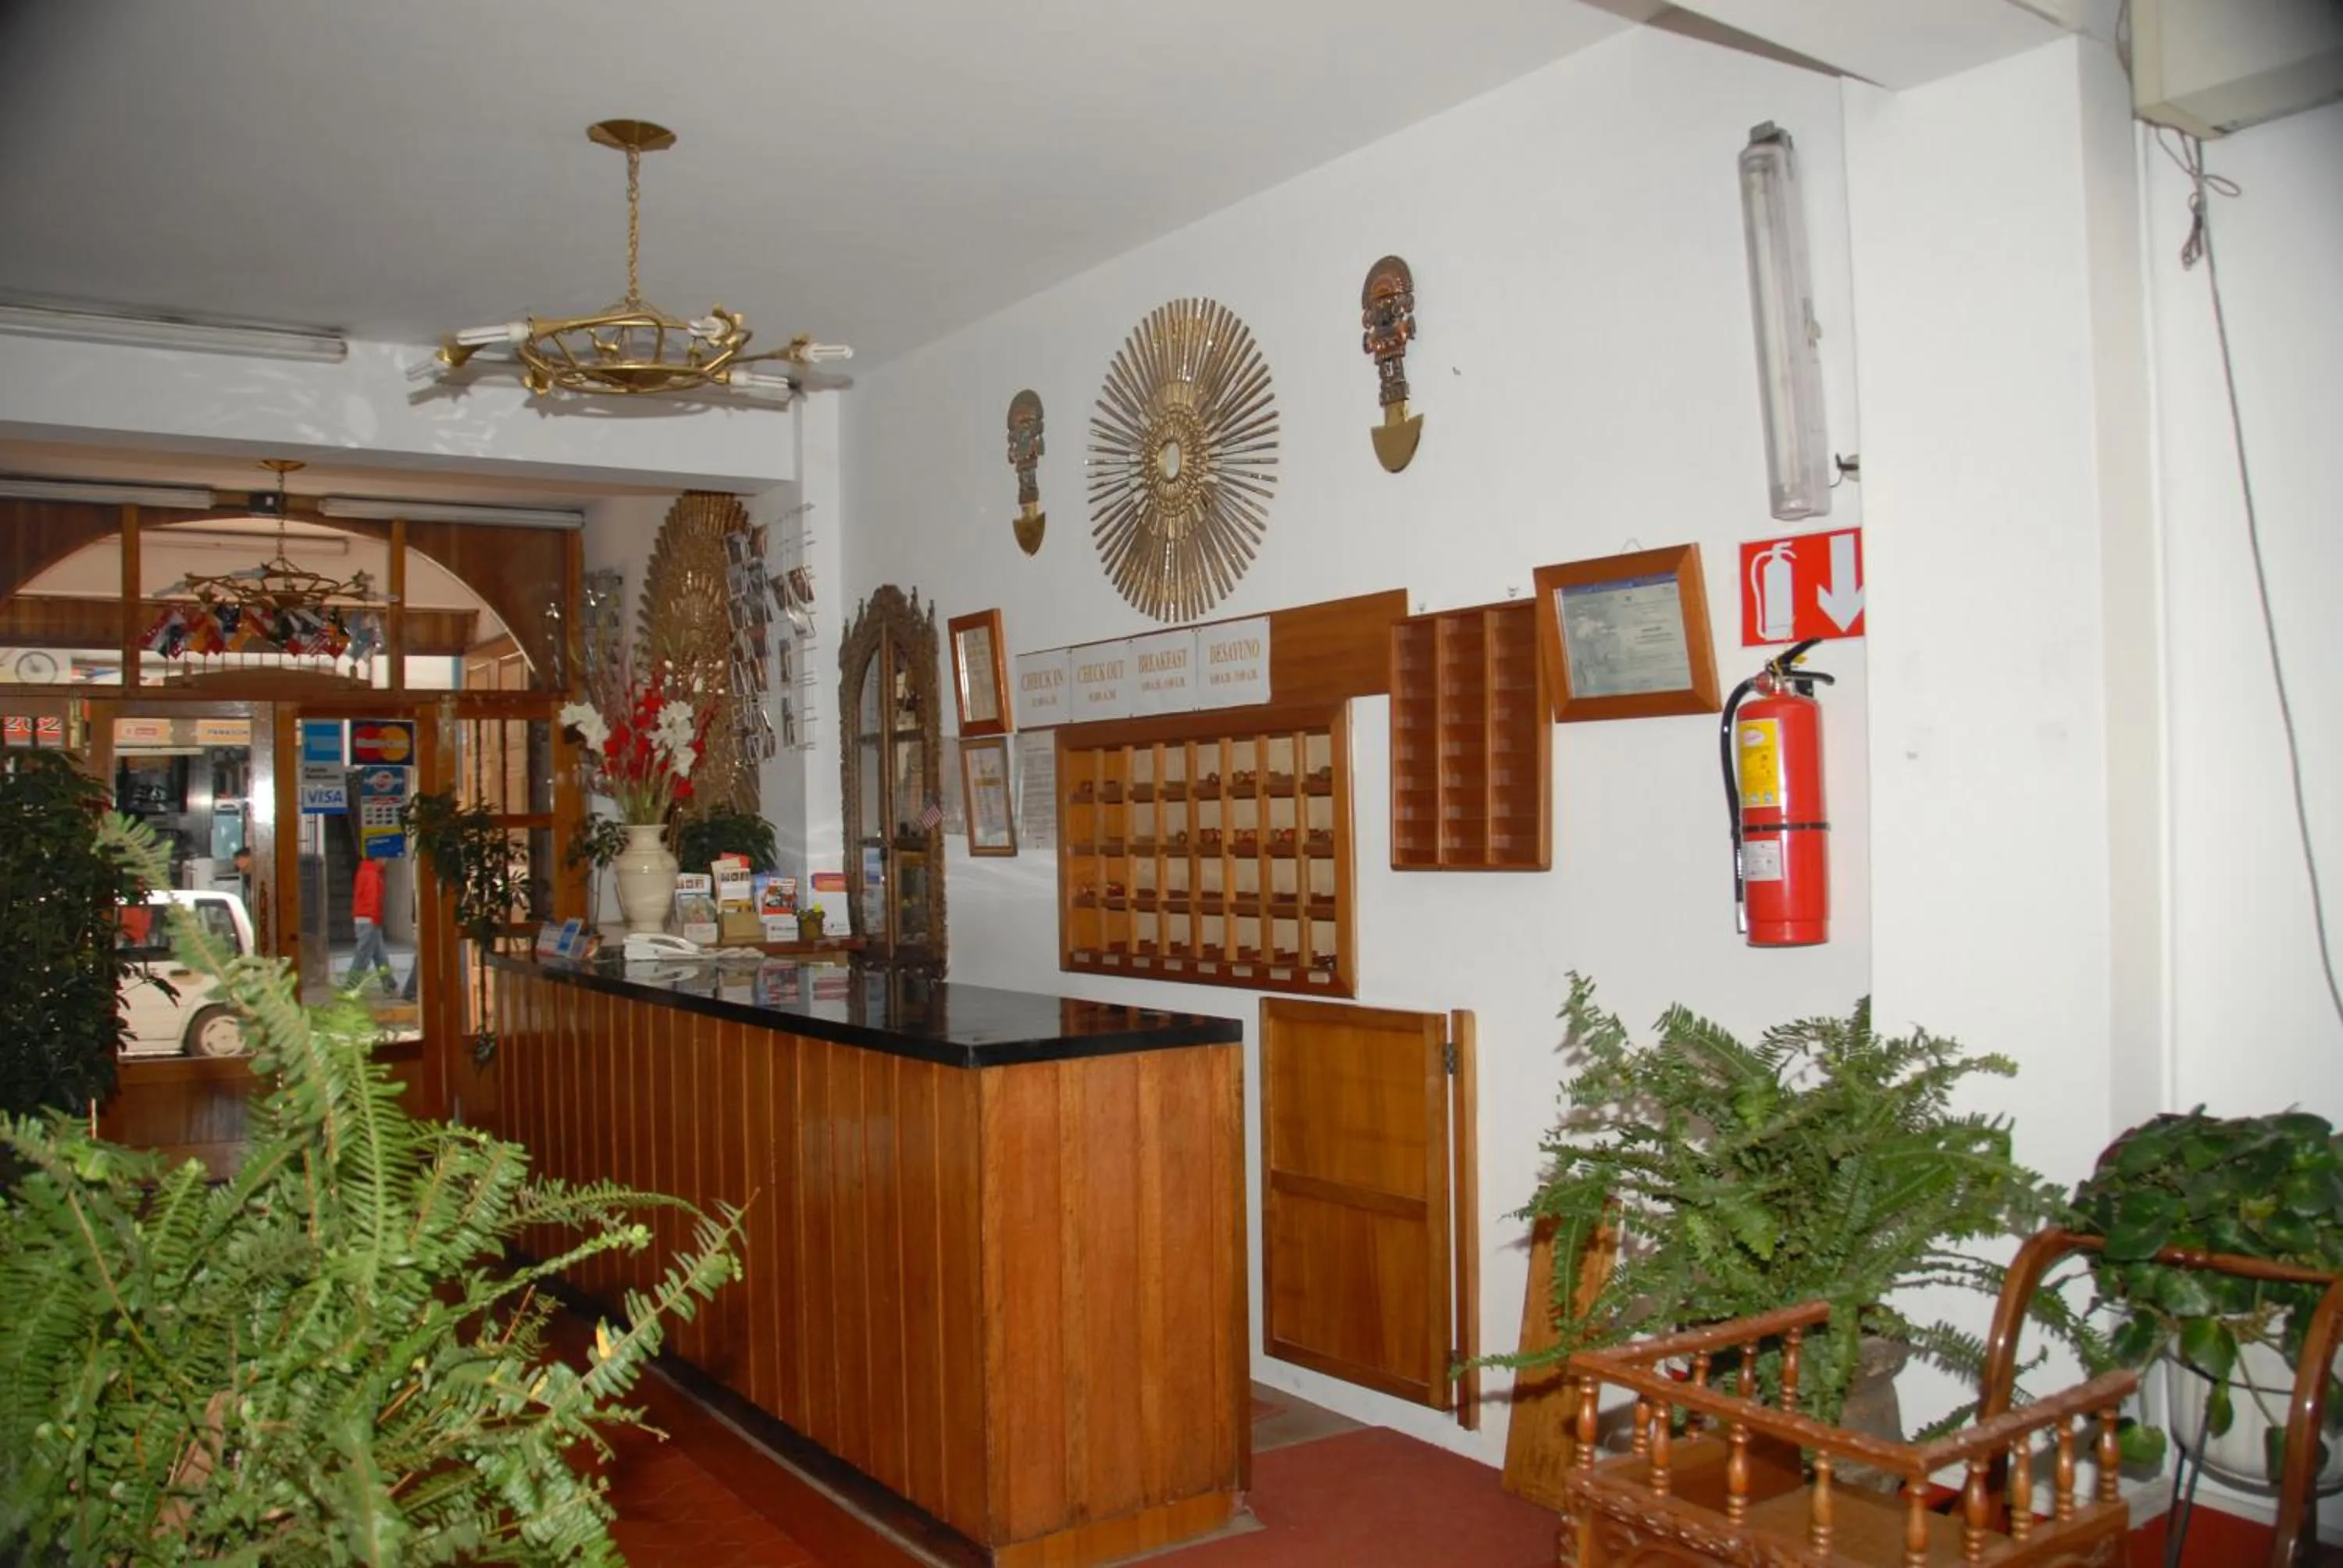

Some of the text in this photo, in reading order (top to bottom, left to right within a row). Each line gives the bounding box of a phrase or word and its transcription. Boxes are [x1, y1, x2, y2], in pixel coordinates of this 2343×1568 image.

[1138, 648, 1188, 674] BREAKFAST
[1209, 638, 1261, 665] DESAYUNO
[1021, 666, 1065, 693] CHECK IN
[1078, 659, 1125, 684] CHECK OUT
[308, 789, 344, 804] VISA
